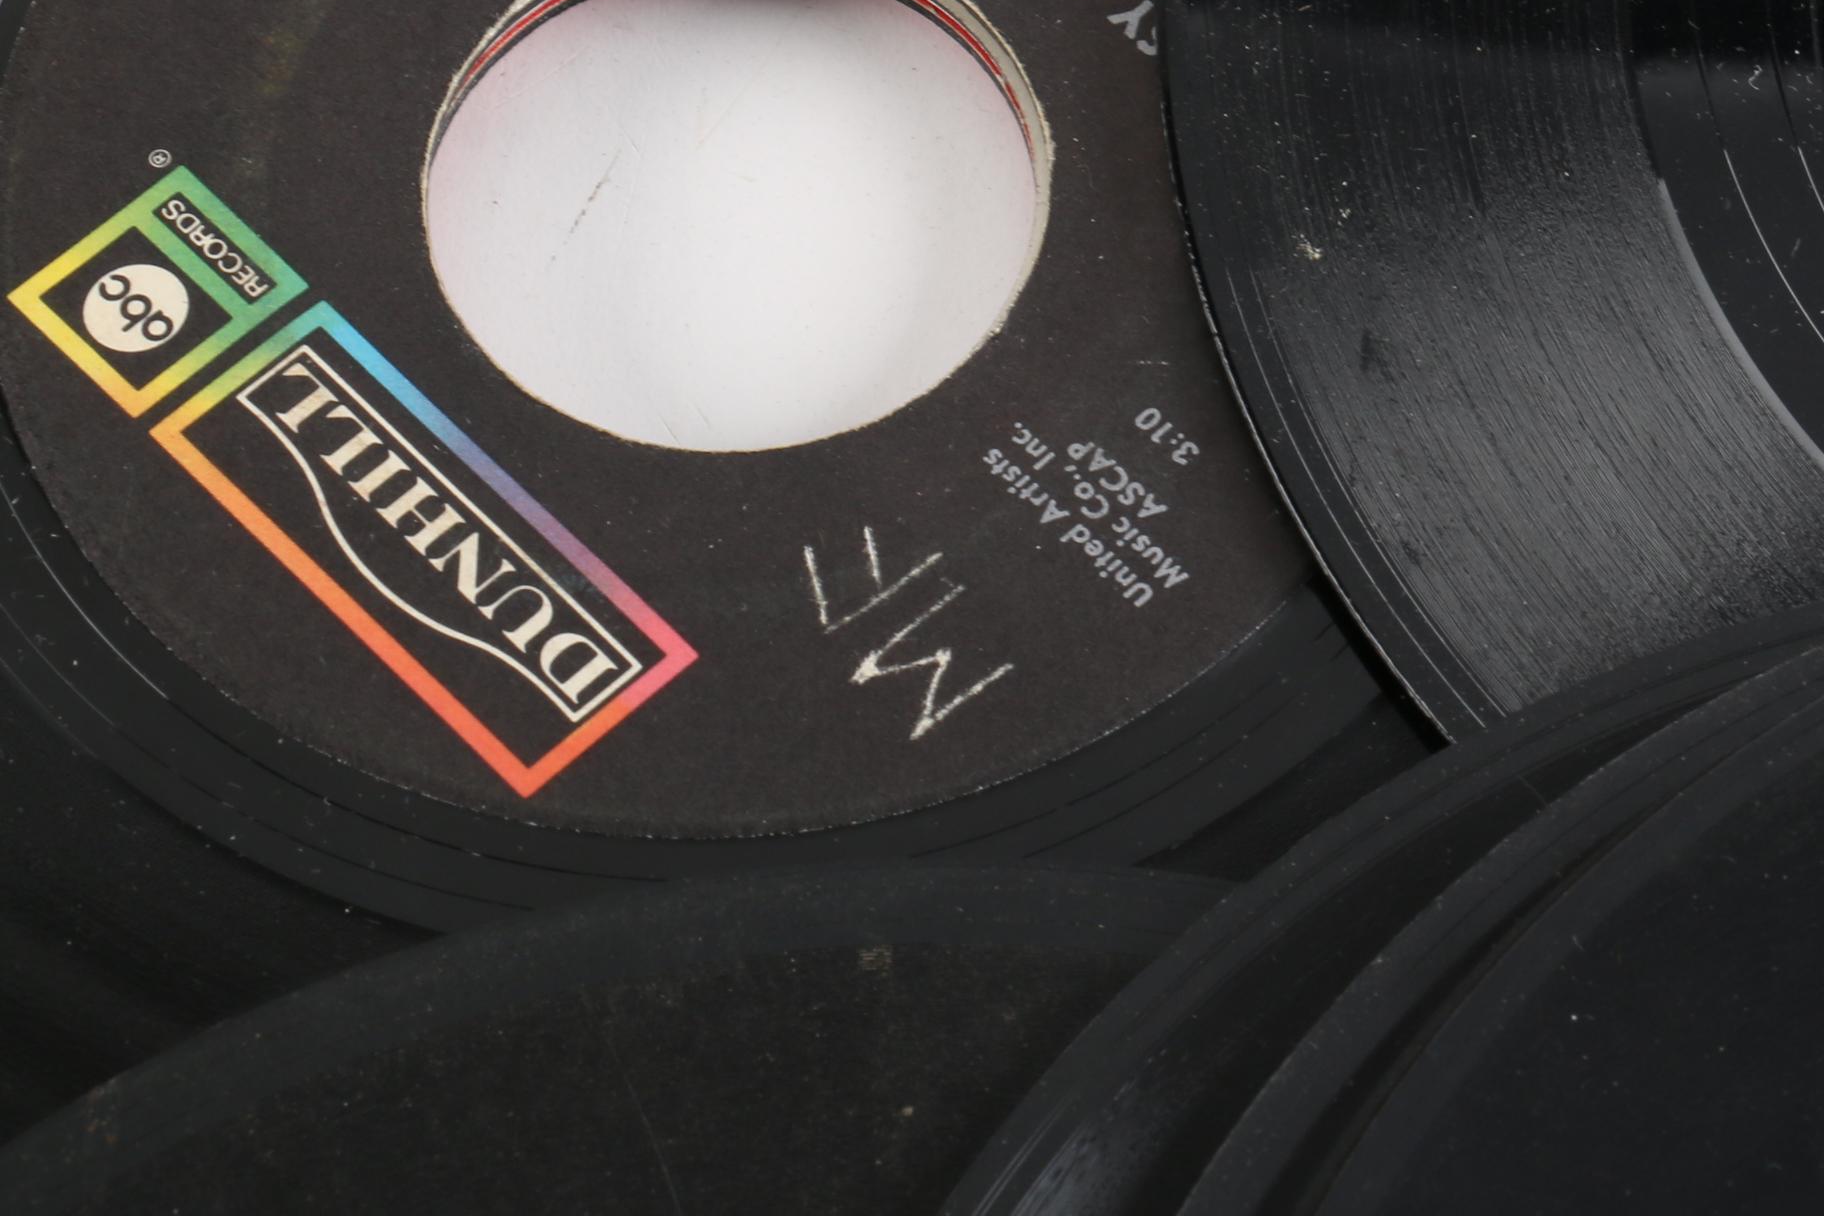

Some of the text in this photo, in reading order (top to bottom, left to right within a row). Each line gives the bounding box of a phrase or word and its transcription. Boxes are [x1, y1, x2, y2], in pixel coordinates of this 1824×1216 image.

[161, 199, 268, 297] RECORDS
[99, 274, 174, 342] abc
[1011, 421, 1056, 471] Inc.
[1134, 406, 1199, 466] 3:10
[1066, 441, 1168, 519] ASCAP
[276, 362, 618, 704] DUNHILL
[982, 448, 1154, 608] United Artists
[1111, 516, 1190, 589] Music
